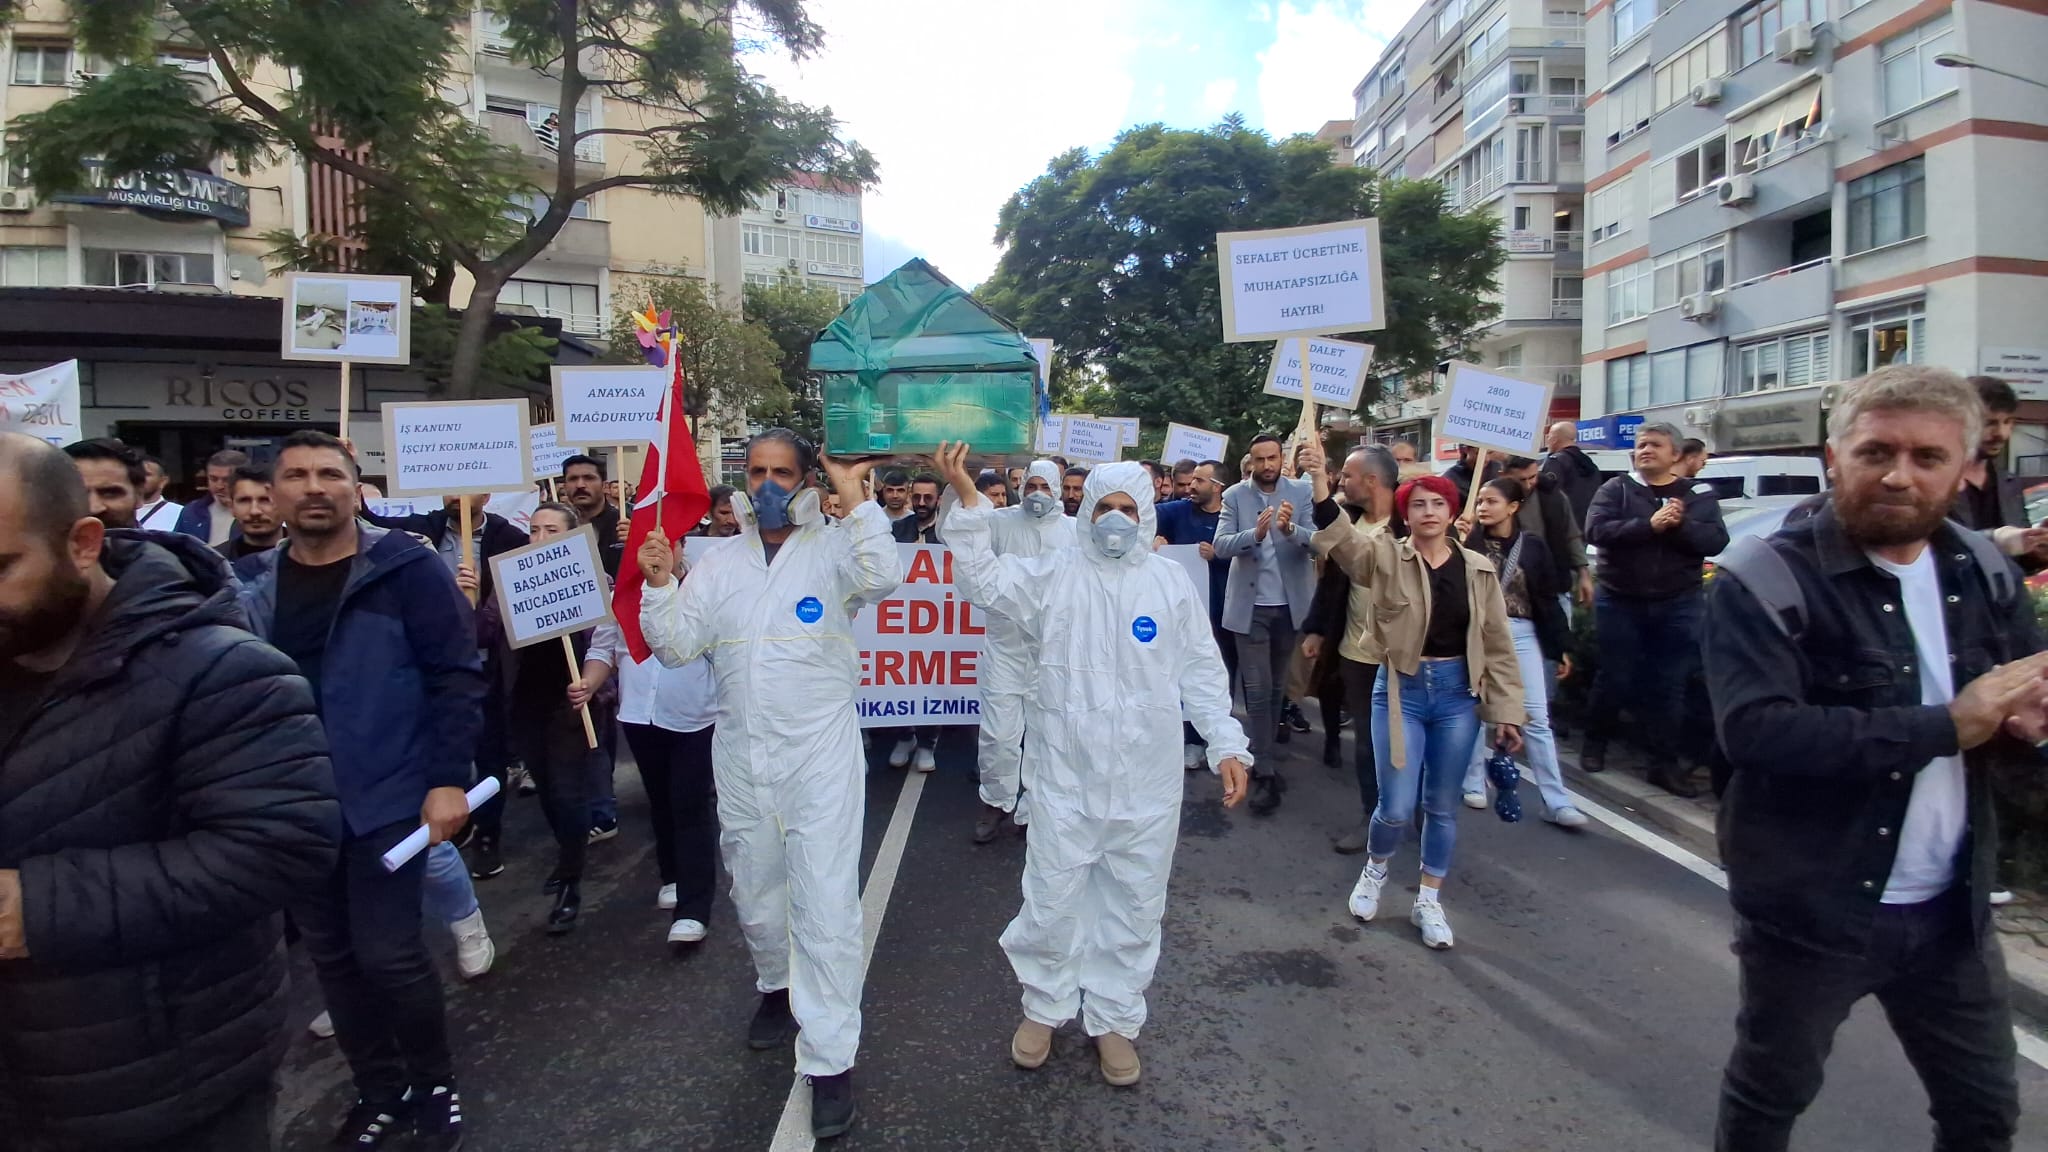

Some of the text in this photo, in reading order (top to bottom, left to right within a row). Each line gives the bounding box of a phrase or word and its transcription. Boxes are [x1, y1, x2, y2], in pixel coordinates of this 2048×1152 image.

[187, 200, 212, 214] LTD.
[1235, 242, 1363, 265] SEFALET ÜCRETİNE,
[1244, 270, 1359, 293] MUHATAPSIZLIĞA
[1280, 303, 1325, 318] HAYIR!
[1309, 344, 1346, 358] DALET
[1287, 357, 1349, 379] İSTYORUZ,
[587, 387, 646, 399] ANAYASA
[1276, 374, 1351, 397] LÜTU DEĞİL!
[1487, 385, 1511, 398] 2800
[223, 408, 311, 420] COFFEE
[569, 410, 659, 424] MAĞDURUYU
[1463, 398, 1526, 421] İŞÇİNİN SESİ
[400, 423, 463, 435] İŞ KANUNU
[1447, 414, 1533, 442] SUSTURULAMAZ!
[1577, 427, 1606, 442] TEKEL
[401, 440, 518, 455] İŞÇİYİ KORUMALIDIR,
[403, 462, 454, 473] PATRONU
[517, 545, 571, 571] BU DAHA
[513, 562, 585, 593] BAŞLANGIÇ,
[536, 605, 583, 629] DEVAM!
[877, 592, 986, 635] EDİL
[858, 651, 983, 685] ERME
[923, 696, 980, 715] İZMİR
